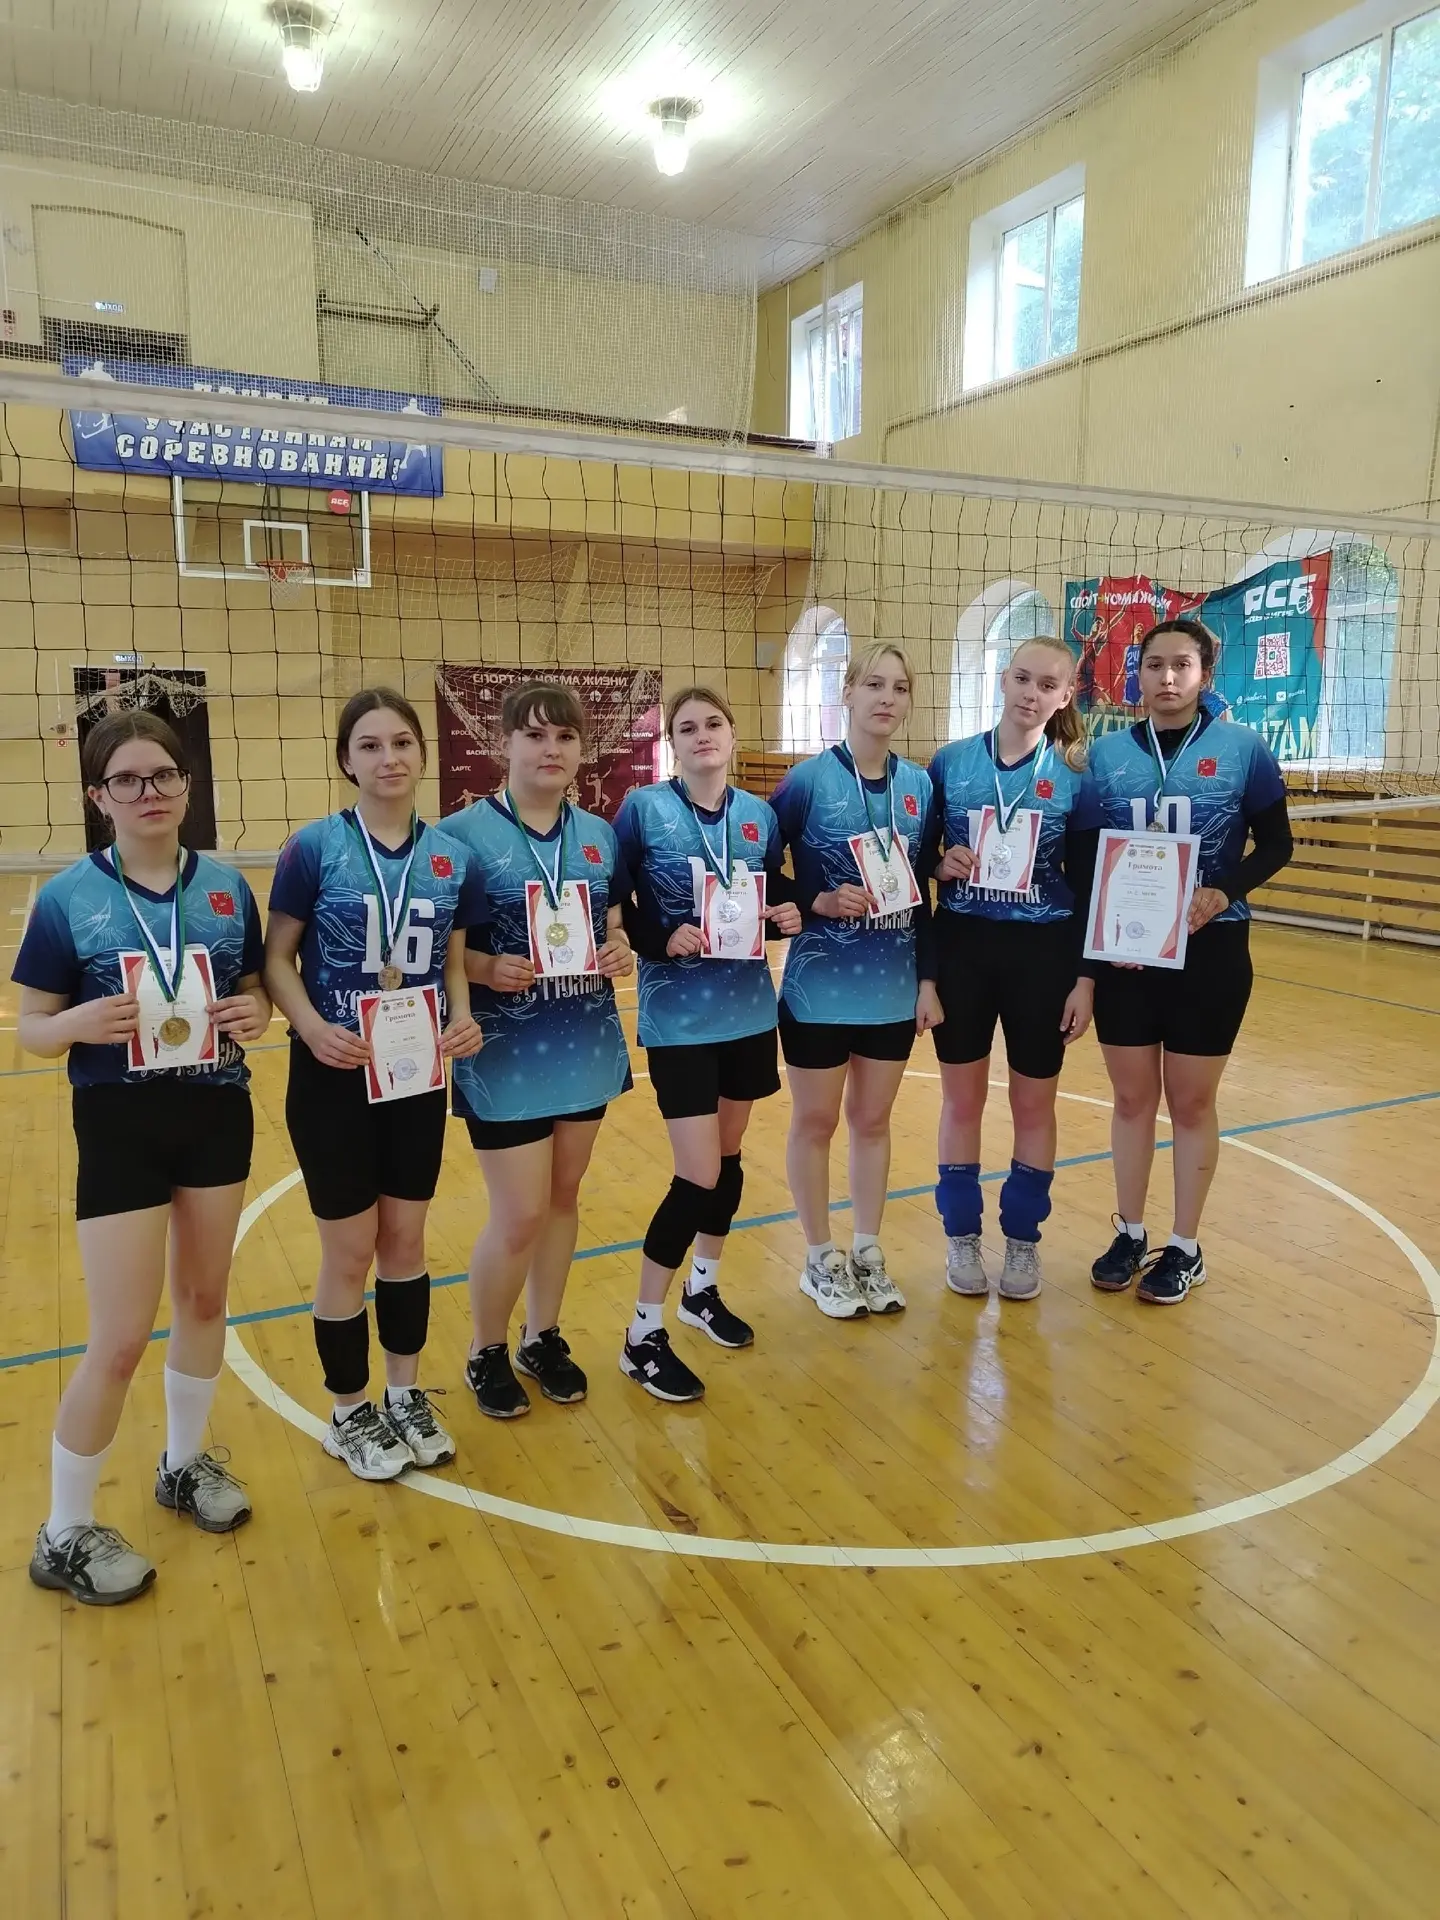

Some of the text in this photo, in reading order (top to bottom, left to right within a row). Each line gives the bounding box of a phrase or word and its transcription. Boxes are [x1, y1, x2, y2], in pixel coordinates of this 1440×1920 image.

[116, 434, 400, 480] СОРЕВНОВАНИЙ!
[1070, 591, 1098, 608] СПОРТ
[1105, 591, 1139, 605] НОРМА
[473, 674, 514, 684] СПОРТ
[583, 676, 627, 686] ЖИЗНИ
[361, 894, 436, 975] 16
[385, 1012, 416, 1023] Грамота
